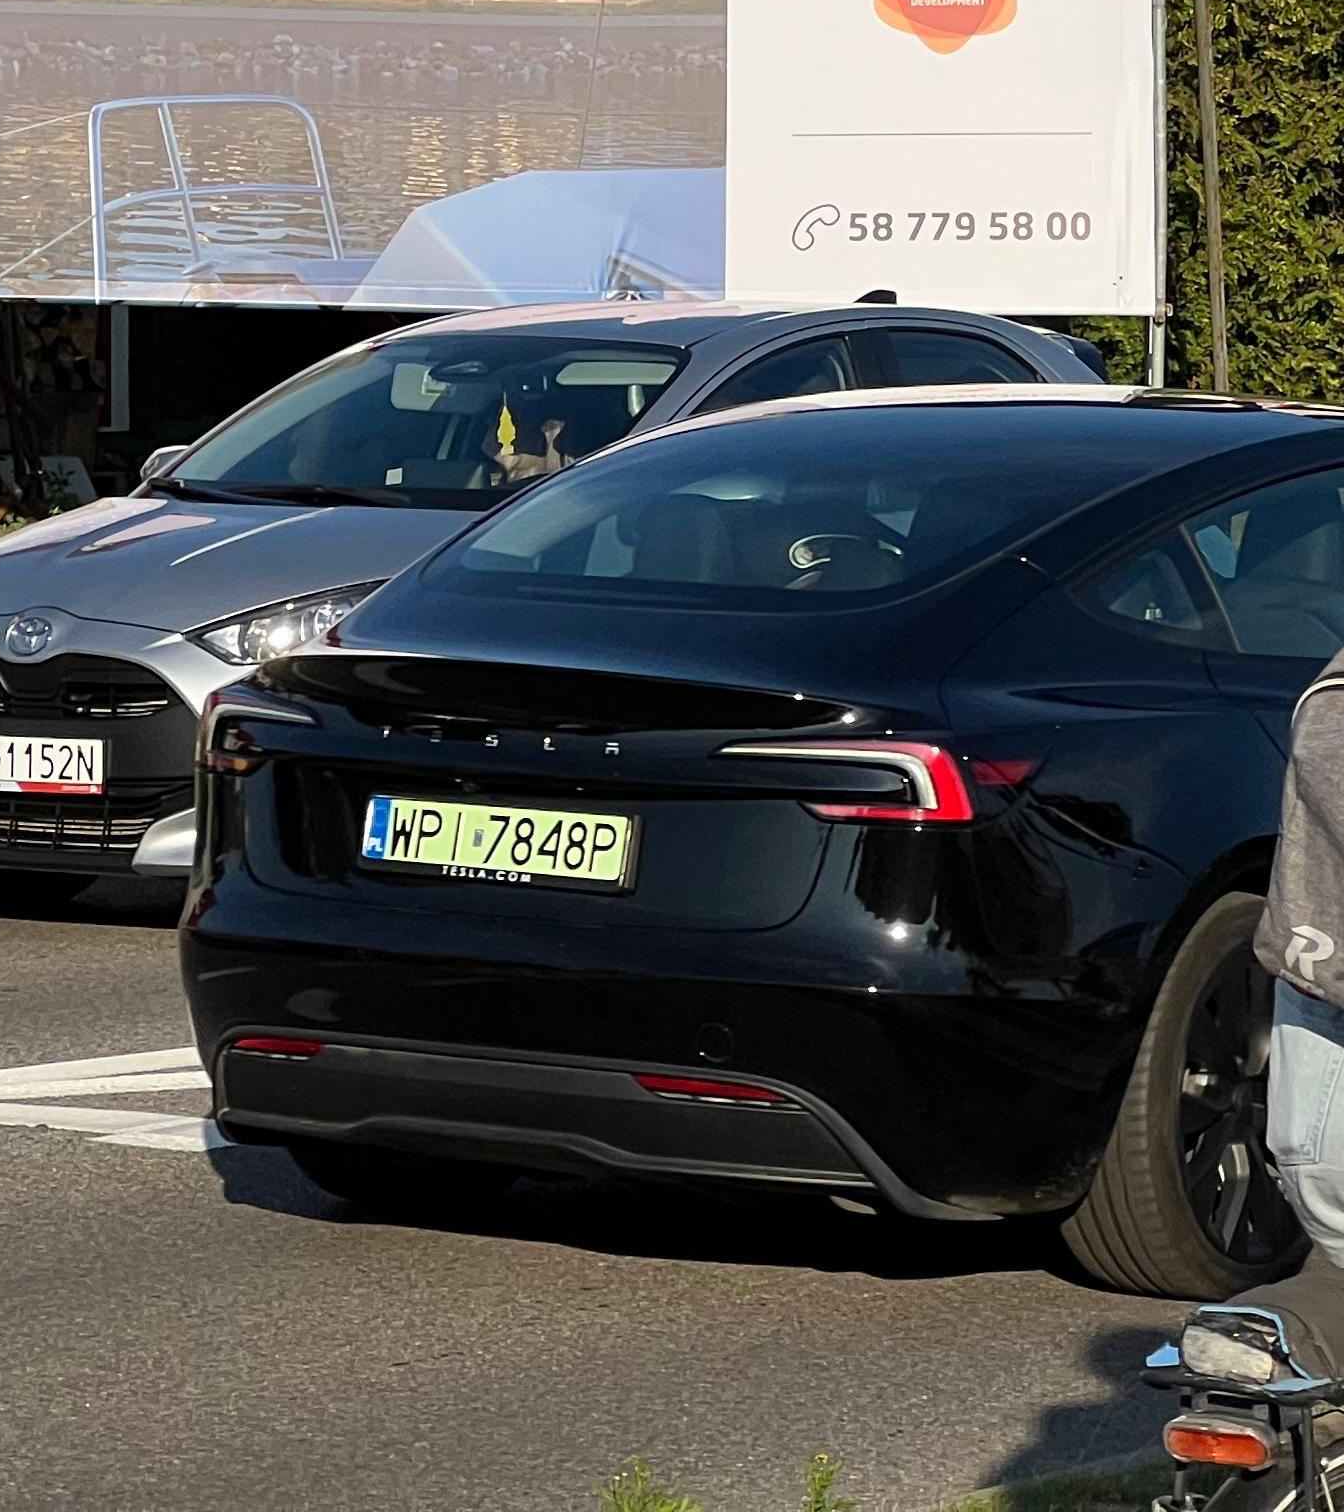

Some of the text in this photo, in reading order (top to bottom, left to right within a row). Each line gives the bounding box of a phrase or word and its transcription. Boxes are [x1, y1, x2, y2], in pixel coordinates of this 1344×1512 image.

[849, 211, 1092, 242] 58 779 58 00
[7, 742, 94, 781] 1152N
[366, 837, 383, 852] PL
[483, 814, 617, 872] 7848P
[441, 865, 531, 882] TESLA.COM
